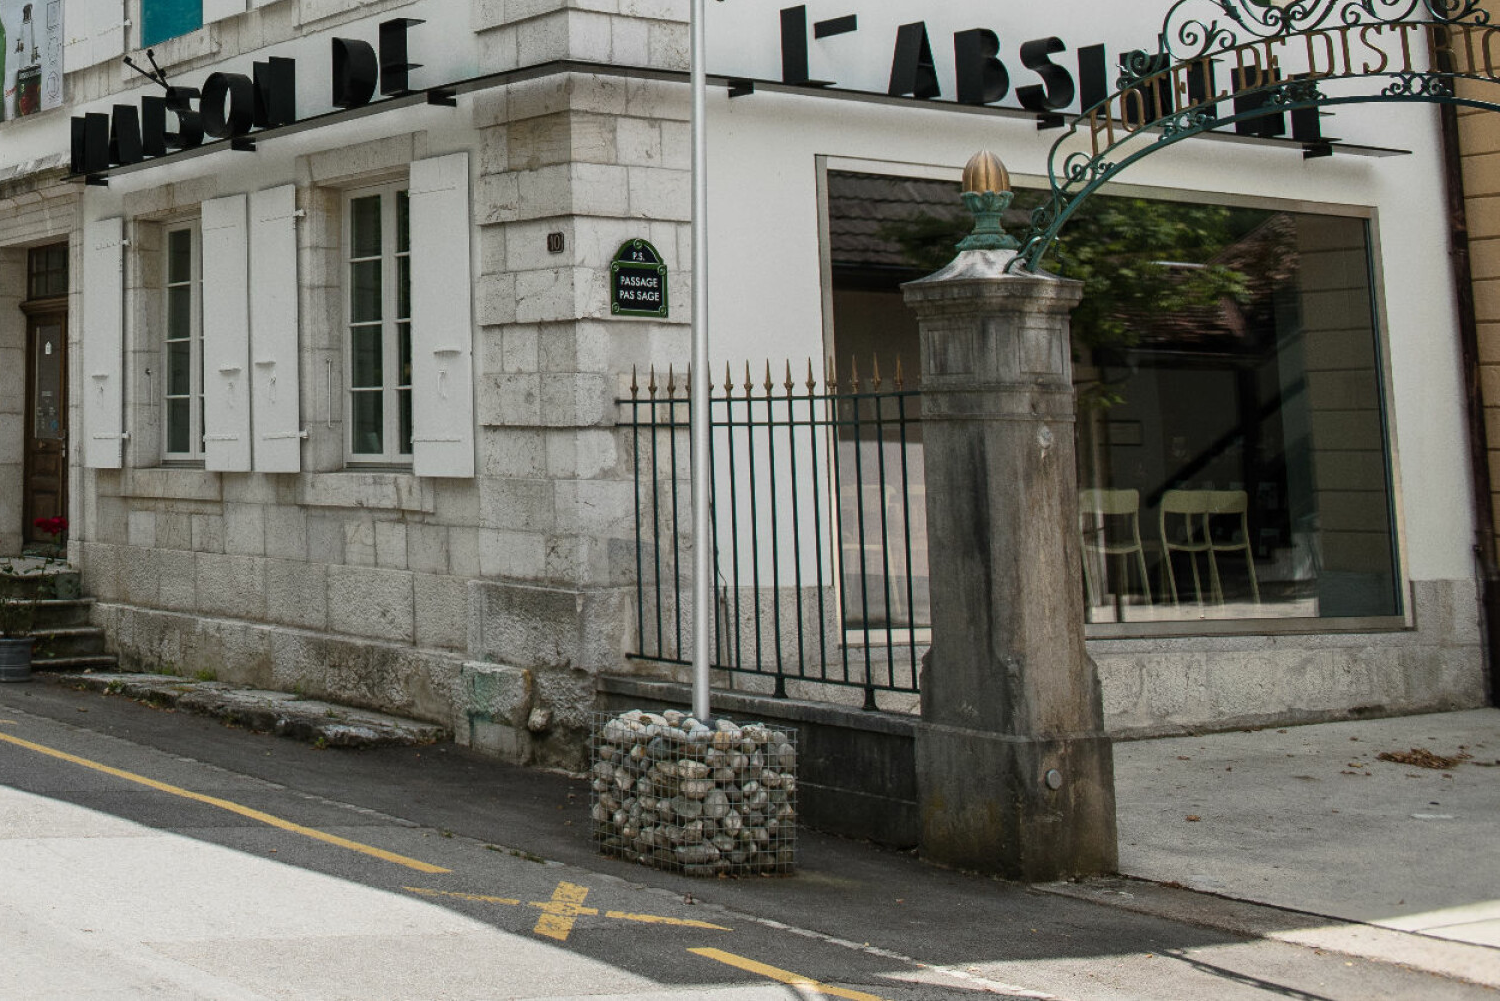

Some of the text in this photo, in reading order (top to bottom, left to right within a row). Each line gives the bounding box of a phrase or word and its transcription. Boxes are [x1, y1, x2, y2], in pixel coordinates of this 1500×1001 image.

[70, 17, 426, 175] MAISON DE
[1090, 56, 1228, 157] HOTEL
[1235, 36, 1296, 91] DE
[619, 289, 660, 302] PAS SAGE
[620, 275, 659, 288] PASSAGE
